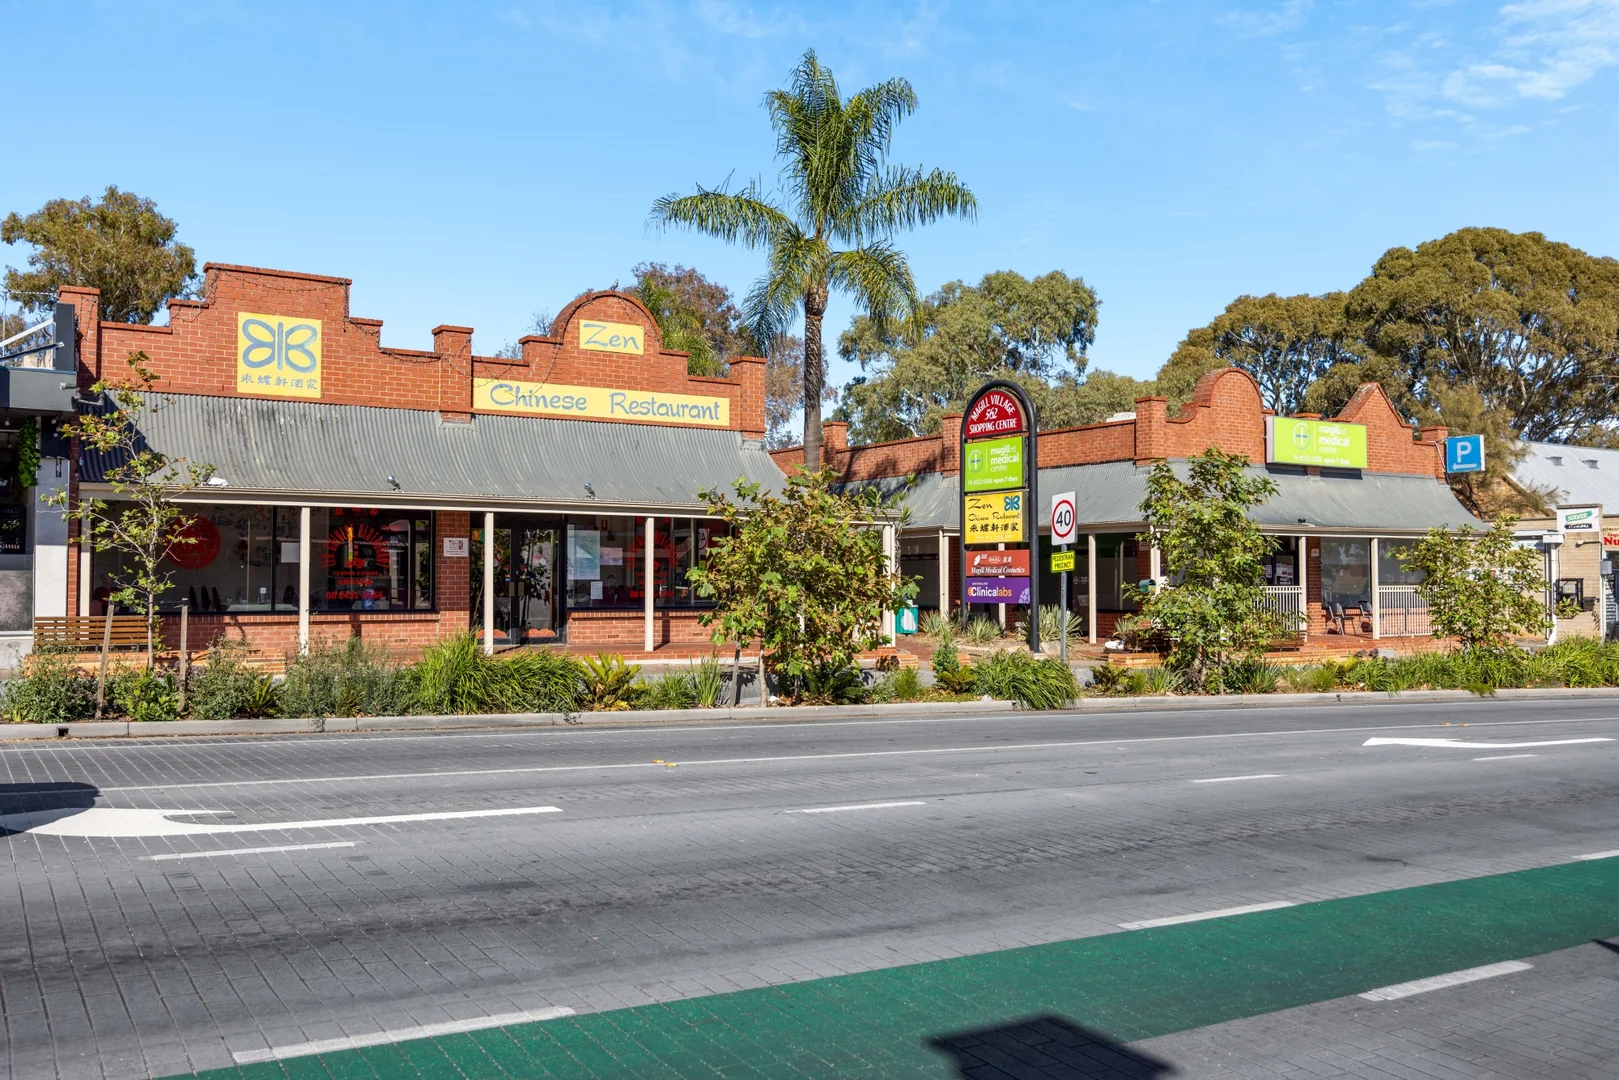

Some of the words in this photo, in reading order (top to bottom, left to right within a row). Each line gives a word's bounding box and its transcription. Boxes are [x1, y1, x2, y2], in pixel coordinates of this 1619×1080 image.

[583, 322, 640, 350] Zen
[490, 383, 587, 411] Chinese
[609, 391, 720, 420] Restaurant
[971, 397, 990, 421] MAGILL
[990, 394, 1016, 415] VILLAGE
[969, 421, 995, 434] SHOPPING
[995, 418, 1017, 430] CENTRE
[1319, 424, 1341, 436] magill
[1319, 435, 1350, 447] medical
[990, 444, 1010, 456] magill
[1319, 446, 1338, 454] centre
[1456, 441, 1472, 463] P
[990, 452, 1020, 465] medical
[1339, 458, 1351, 466] days
[968, 498, 993, 509] Zen
[968, 513, 989, 521] Chinese
[992, 511, 1020, 520] Restaurant
[1055, 509, 1072, 527] 40
[1053, 554, 1074, 562] PEDESTRIAN
[971, 566, 985, 575] Magill
